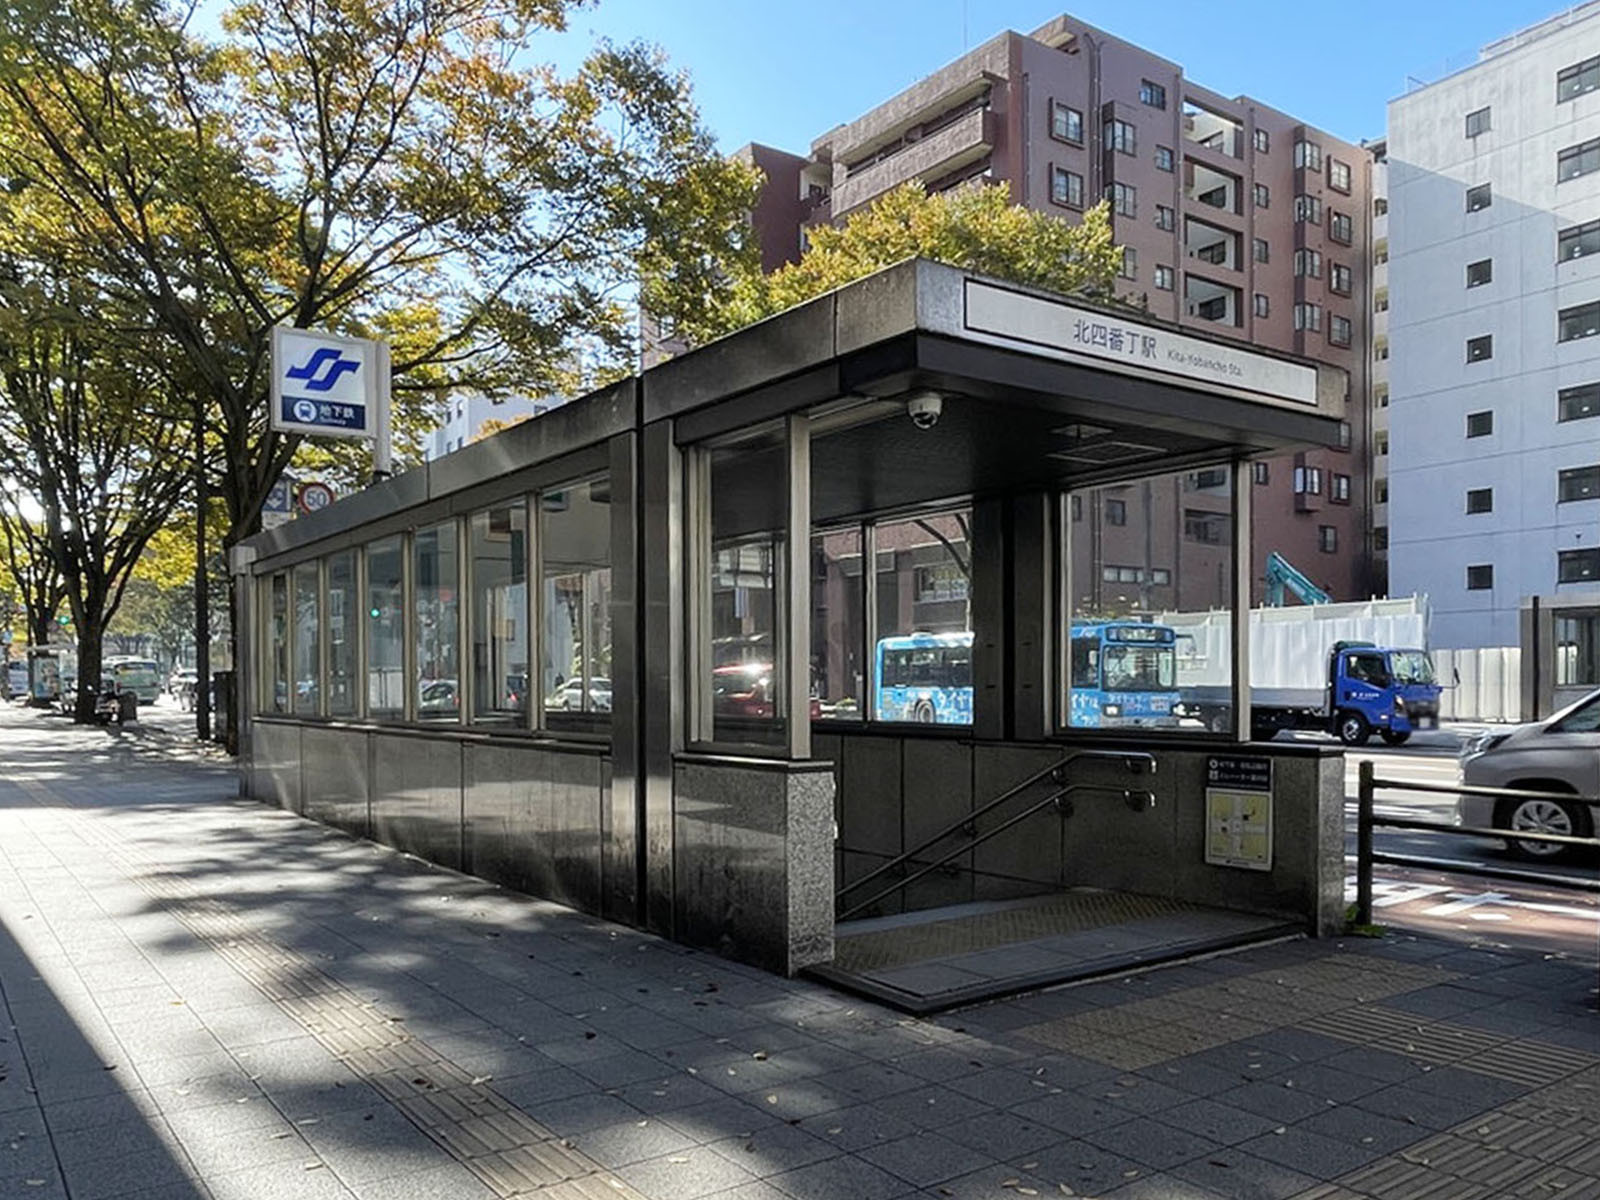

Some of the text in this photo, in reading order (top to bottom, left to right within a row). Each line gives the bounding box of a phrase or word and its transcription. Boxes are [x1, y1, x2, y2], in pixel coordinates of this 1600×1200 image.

[1074, 320, 1157, 359] 北四番丁駅
